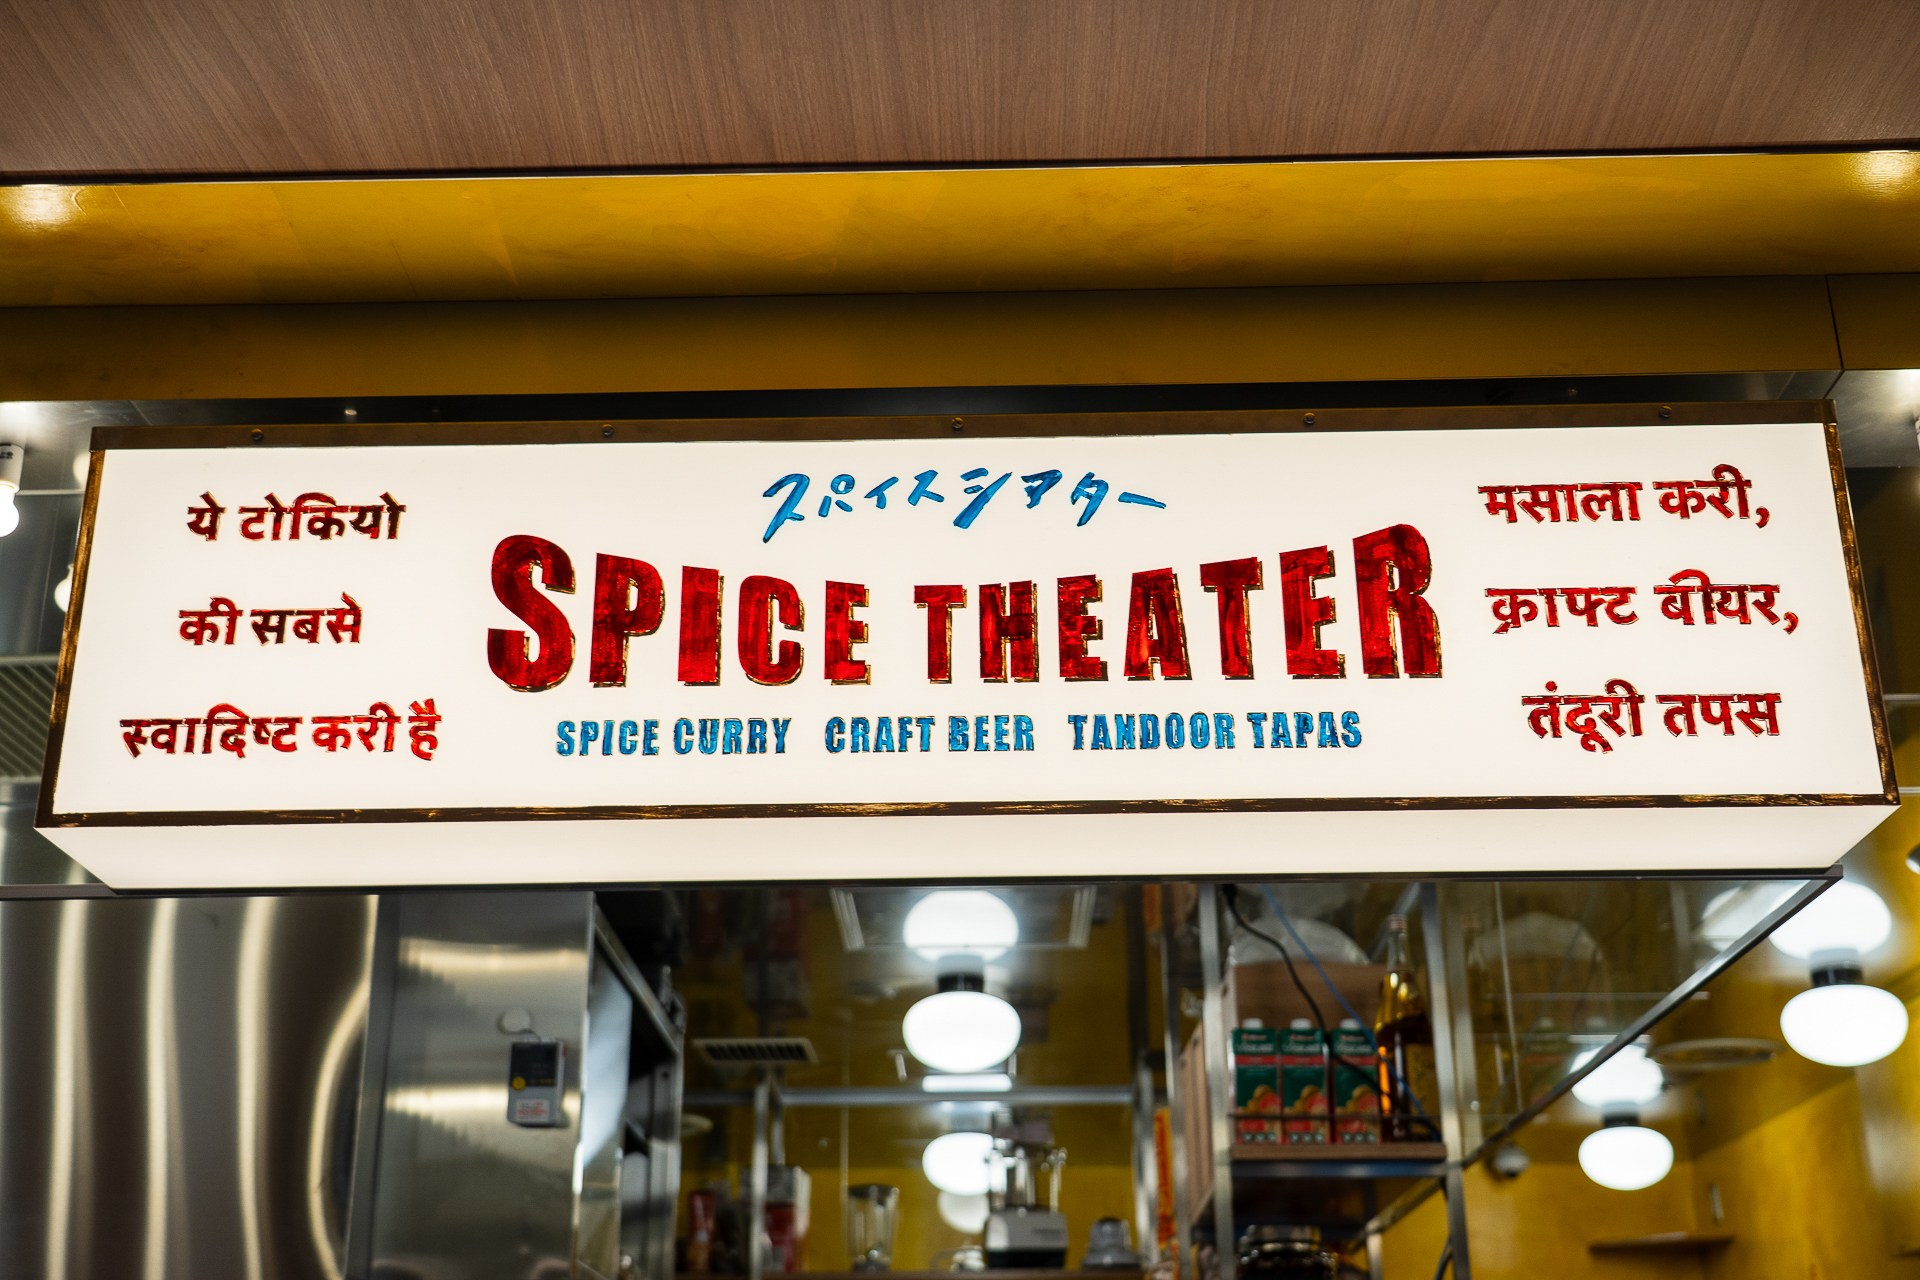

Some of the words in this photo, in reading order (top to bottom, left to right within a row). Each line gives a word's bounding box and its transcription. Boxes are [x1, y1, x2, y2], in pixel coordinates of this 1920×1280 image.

[186, 491, 226, 541] ये
[238, 492, 407, 541] टोकियो
[763, 468, 1167, 543] スパイスシアター
[1478, 482, 1643, 524] मसाला
[1652, 464, 1771, 528] करी,
[178, 597, 244, 646] की
[250, 592, 362, 646] सबसे
[487, 535, 871, 693] SPICE
[914, 524, 1443, 684] THEATER
[1484, 587, 1639, 634] क्राफ्ट
[1653, 569, 1799, 635] बीयर,
[120, 703, 303, 760] स्वादिष्ट
[311, 702, 402, 753] करी
[408, 698, 442, 761] है
[556, 719, 660, 756] SPICE
[673, 717, 792, 755] CURRY
[825, 716, 936, 754] CRAFT
[948, 715, 1035, 752] BEER
[1068, 711, 1235, 750] TANDOOR
[1247, 711, 1362, 749] TAPAS
[1521, 678, 1645, 754] तंदूरी
[1655, 693, 1782, 737] तपस
